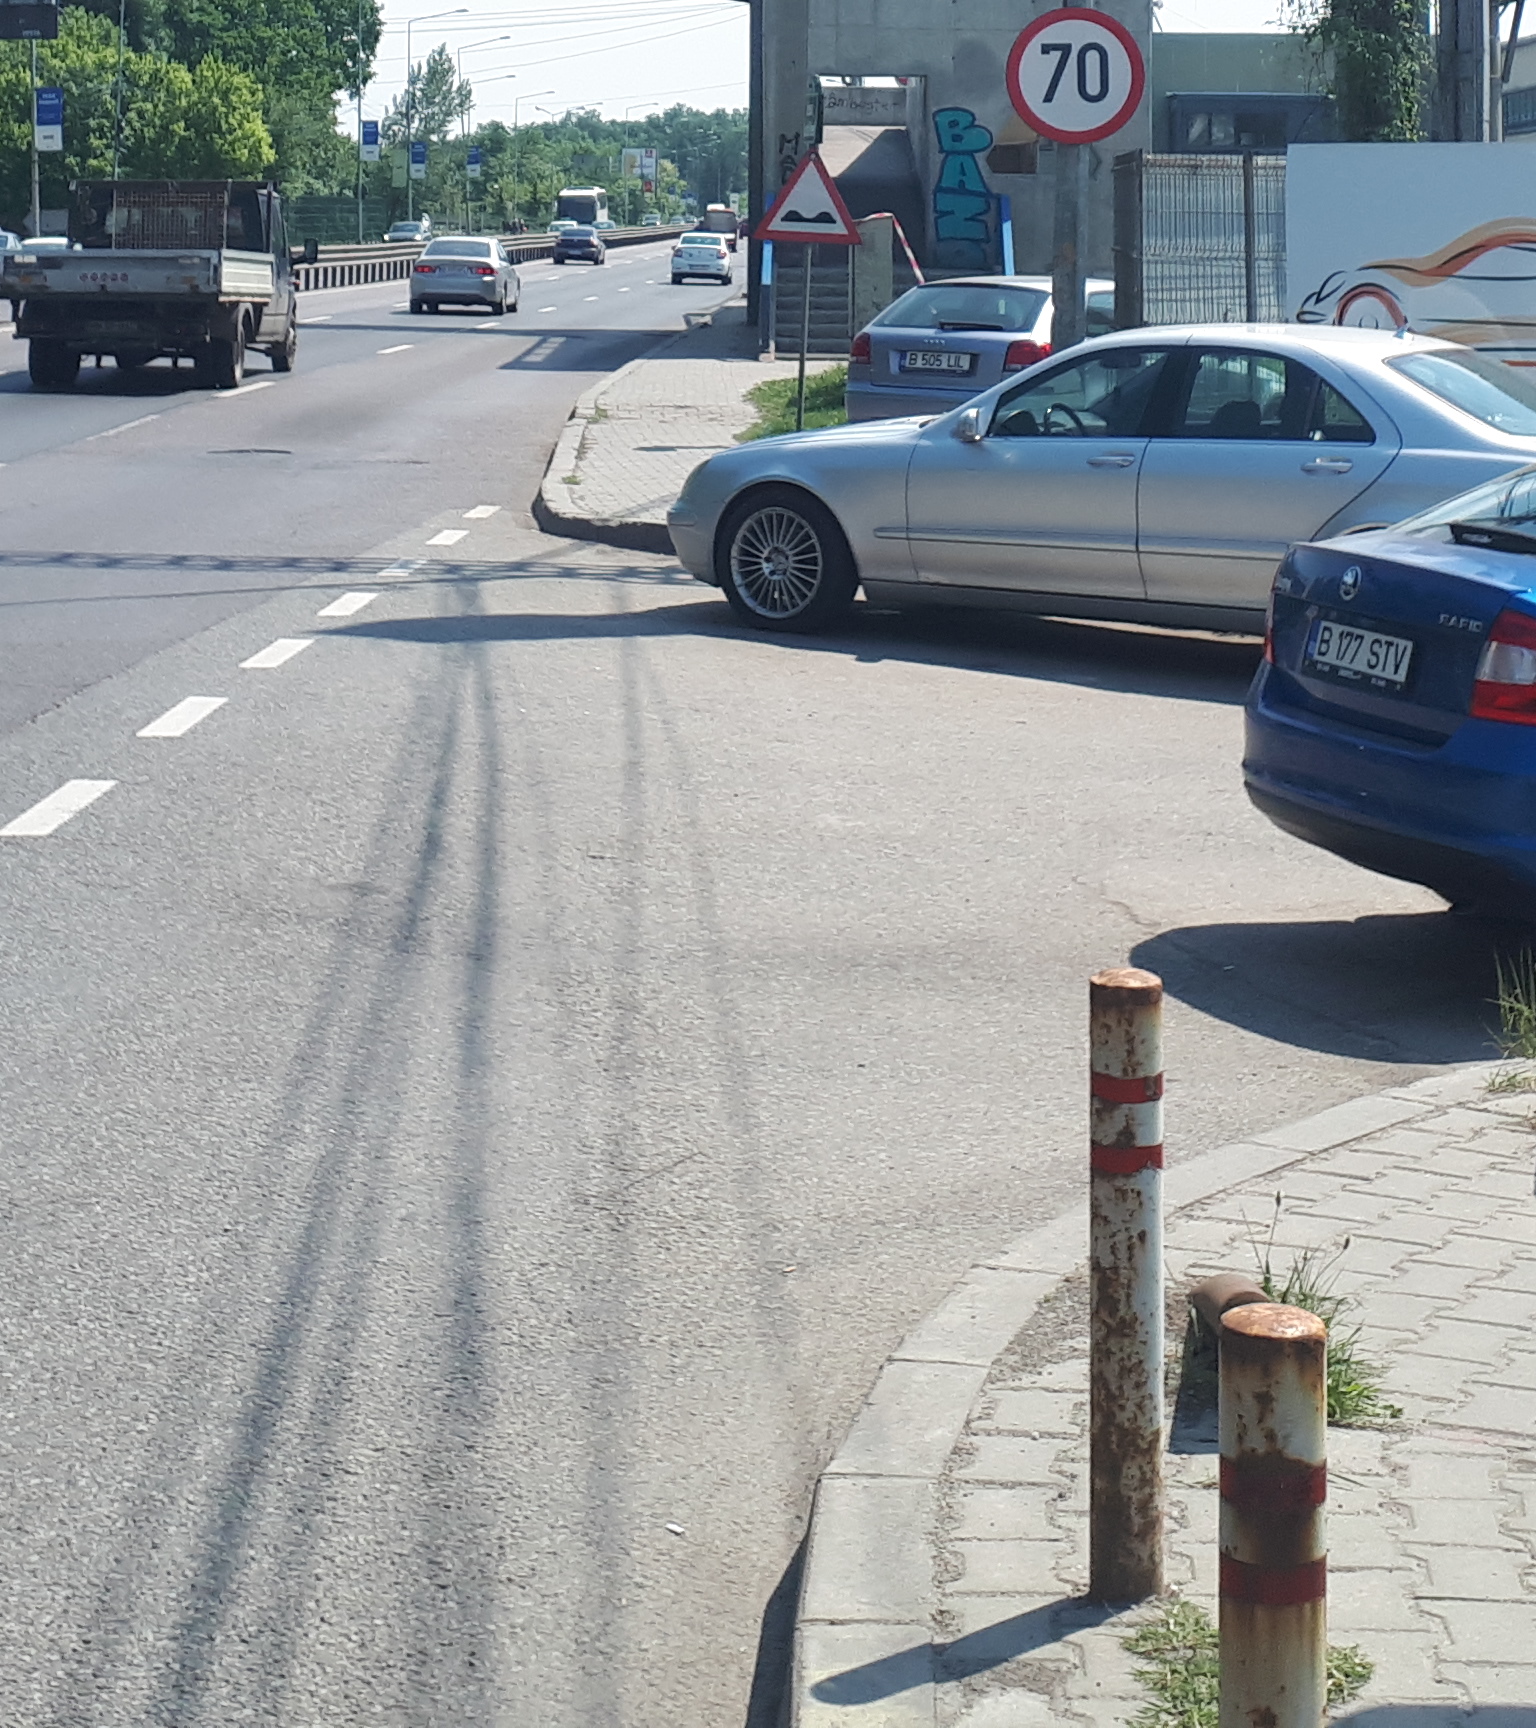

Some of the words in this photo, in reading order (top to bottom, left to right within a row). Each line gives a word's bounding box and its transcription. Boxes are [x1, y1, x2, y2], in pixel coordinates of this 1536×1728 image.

[1040, 42, 1110, 104] 70
[909, 353, 918, 365] B
[921, 354, 942, 367] 505
[1317, 625, 1333, 657] B
[1336, 630, 1364, 665] 177
[1367, 638, 1409, 676] STV
